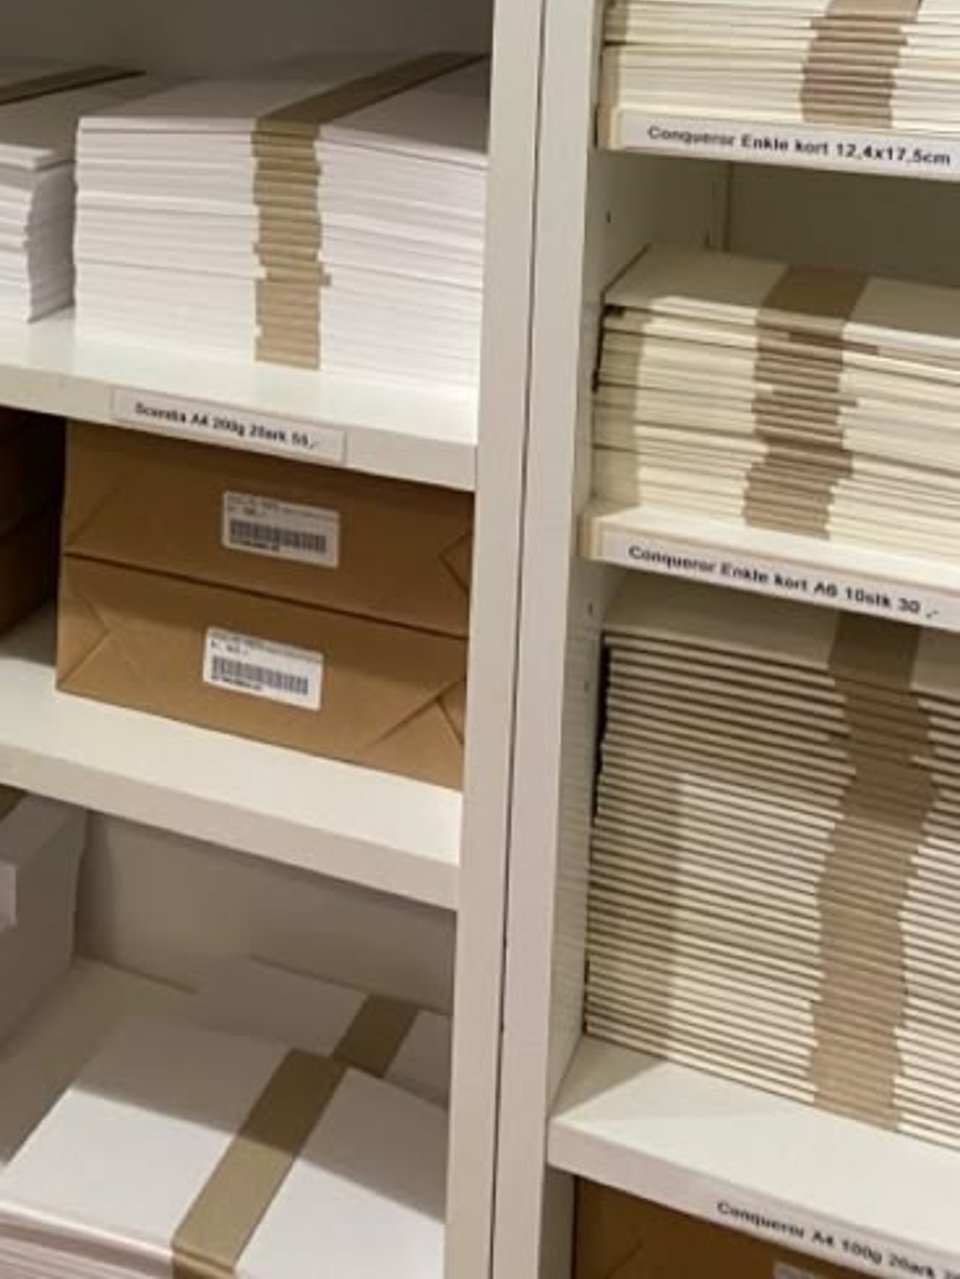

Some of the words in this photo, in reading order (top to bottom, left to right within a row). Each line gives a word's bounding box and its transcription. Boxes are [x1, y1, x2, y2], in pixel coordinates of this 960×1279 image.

[646, 124, 735, 147] Conqueror
[741, 133, 788, 151] Enkle
[795, 138, 829, 156] kort
[190, 412, 208, 426] A4
[628, 544, 717, 573] Conqueror
[721, 560, 769, 584] Enkle
[774, 572, 808, 592] kort
[845, 587, 891, 609] 10stk
[897, 596, 921, 614] 30
[716, 1200, 805, 1238] Conqueror
[811, 1230, 835, 1247] A4
[841, 1239, 883, 1266] 100g
